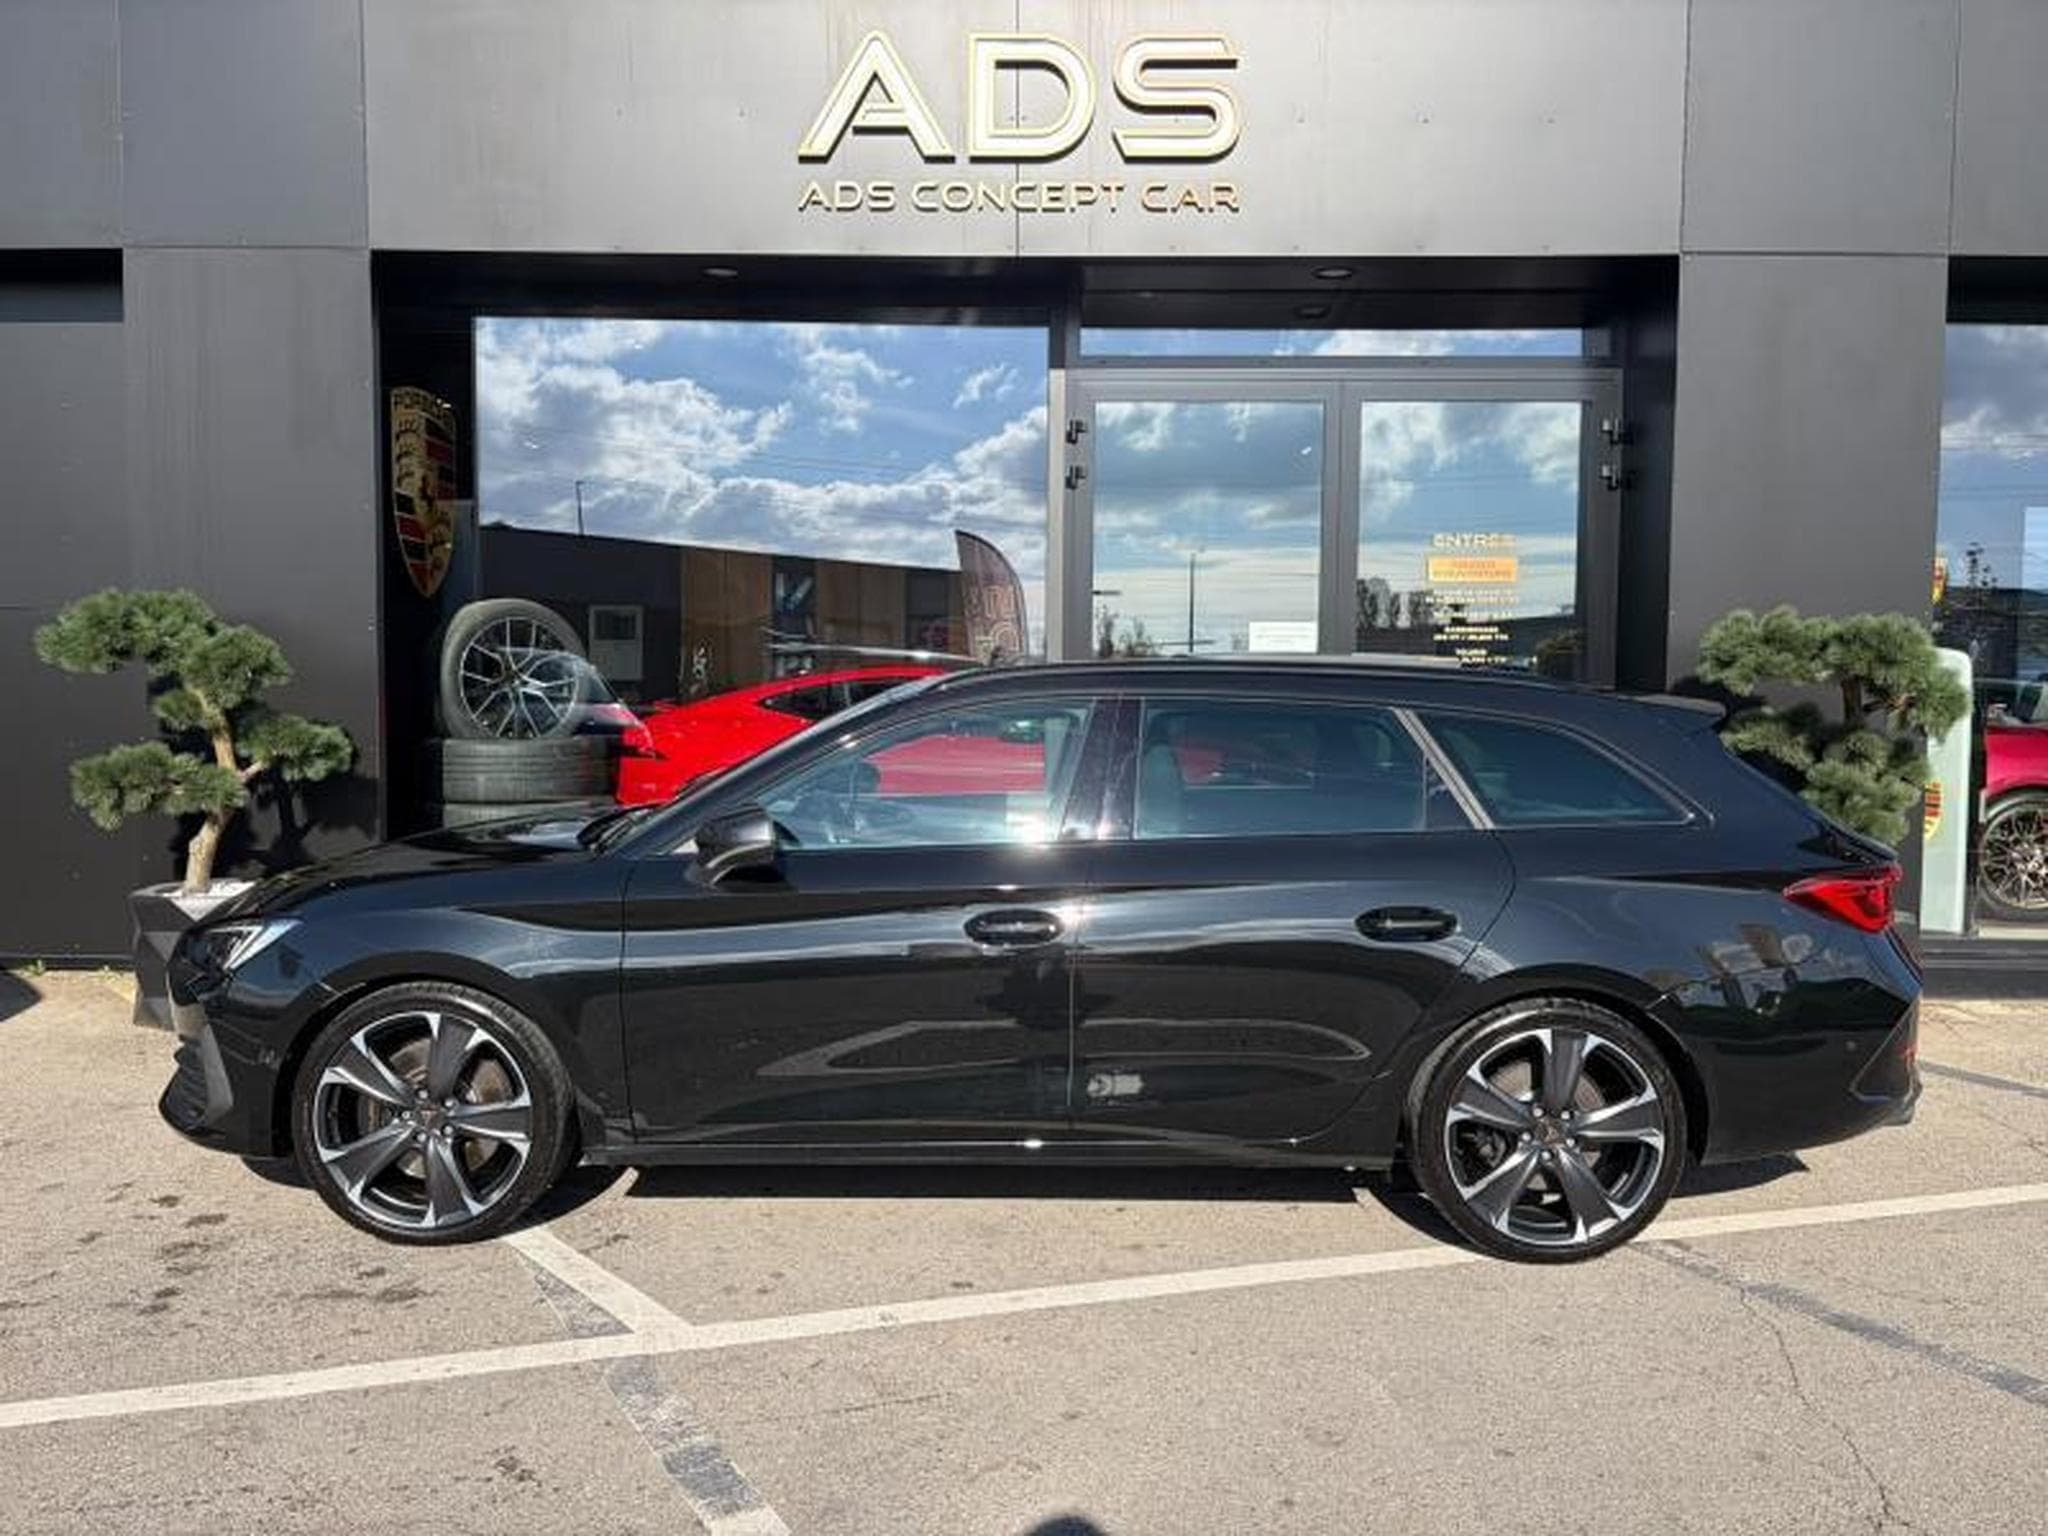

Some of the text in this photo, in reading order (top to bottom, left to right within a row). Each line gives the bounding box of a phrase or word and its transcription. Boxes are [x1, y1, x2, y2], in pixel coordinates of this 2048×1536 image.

[798, 30, 1240, 164] ADS
[798, 181, 1240, 213] ADS CONCEPT CAR
